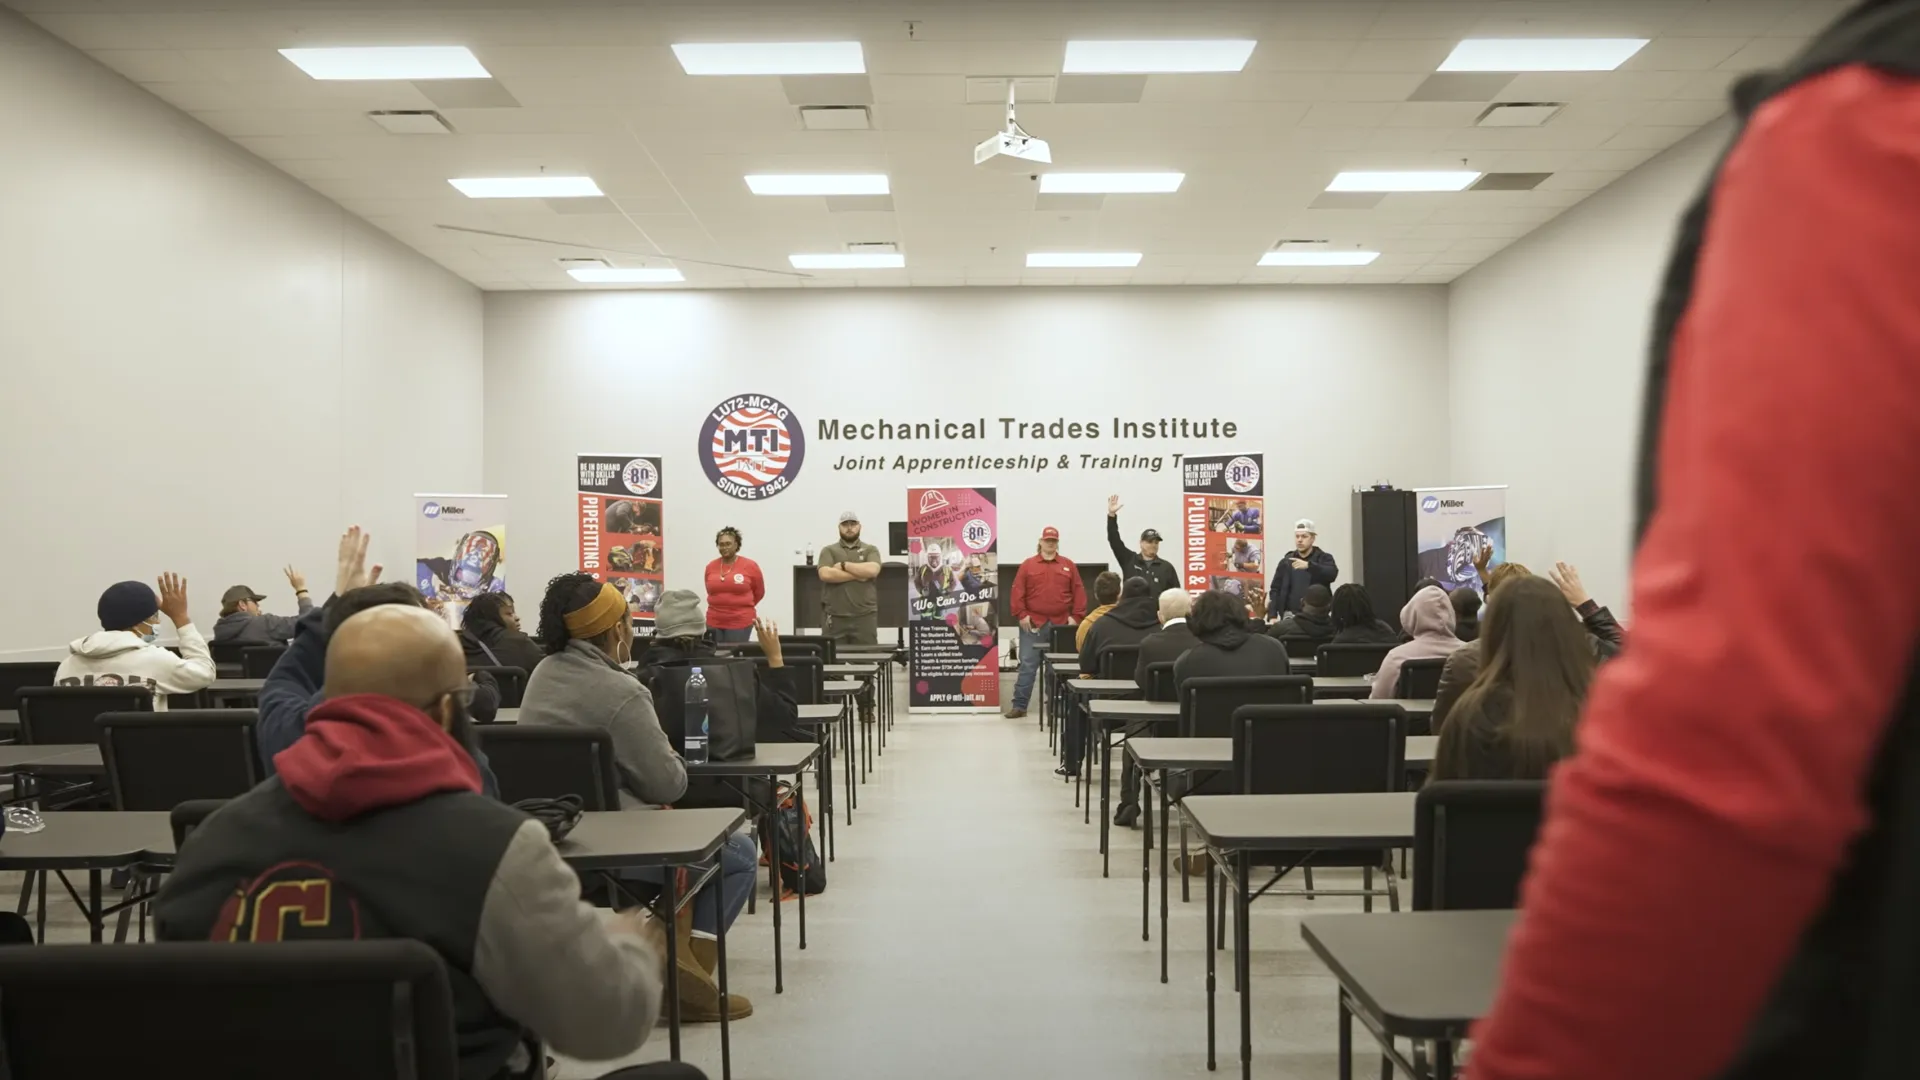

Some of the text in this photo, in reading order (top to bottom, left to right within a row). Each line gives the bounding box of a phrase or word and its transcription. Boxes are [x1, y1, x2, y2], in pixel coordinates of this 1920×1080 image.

[712, 396, 788, 422] LU72-MCAG
[818, 417, 1238, 440] Mechanical Trades Institute
[724, 429, 778, 452] MTI
[580, 463, 620, 471] BE IN DEMAND
[834, 455, 886, 470] Joint
[892, 454, 1048, 473] Apprenticeship
[1057, 454, 1070, 469] &
[1080, 454, 1163, 472] Training
[1200, 463, 1223, 471] DEMAND
[630, 468, 649, 483] 80
[1233, 466, 1251, 482] 80
[716, 476, 788, 498] SINCE 1942
[442, 506, 465, 514] Miller
[1440, 500, 1464, 508] Miller
[910, 505, 959, 526] WOMEN IN
[913, 506, 983, 535] CONSTRUCTION
[583, 497, 600, 568] PIPEFITTING
[968, 527, 984, 540] 80
[1188, 498, 1206, 571] PLUMBING
[1188, 575, 1206, 585] &
[913, 588, 993, 611] We Can Do It!
